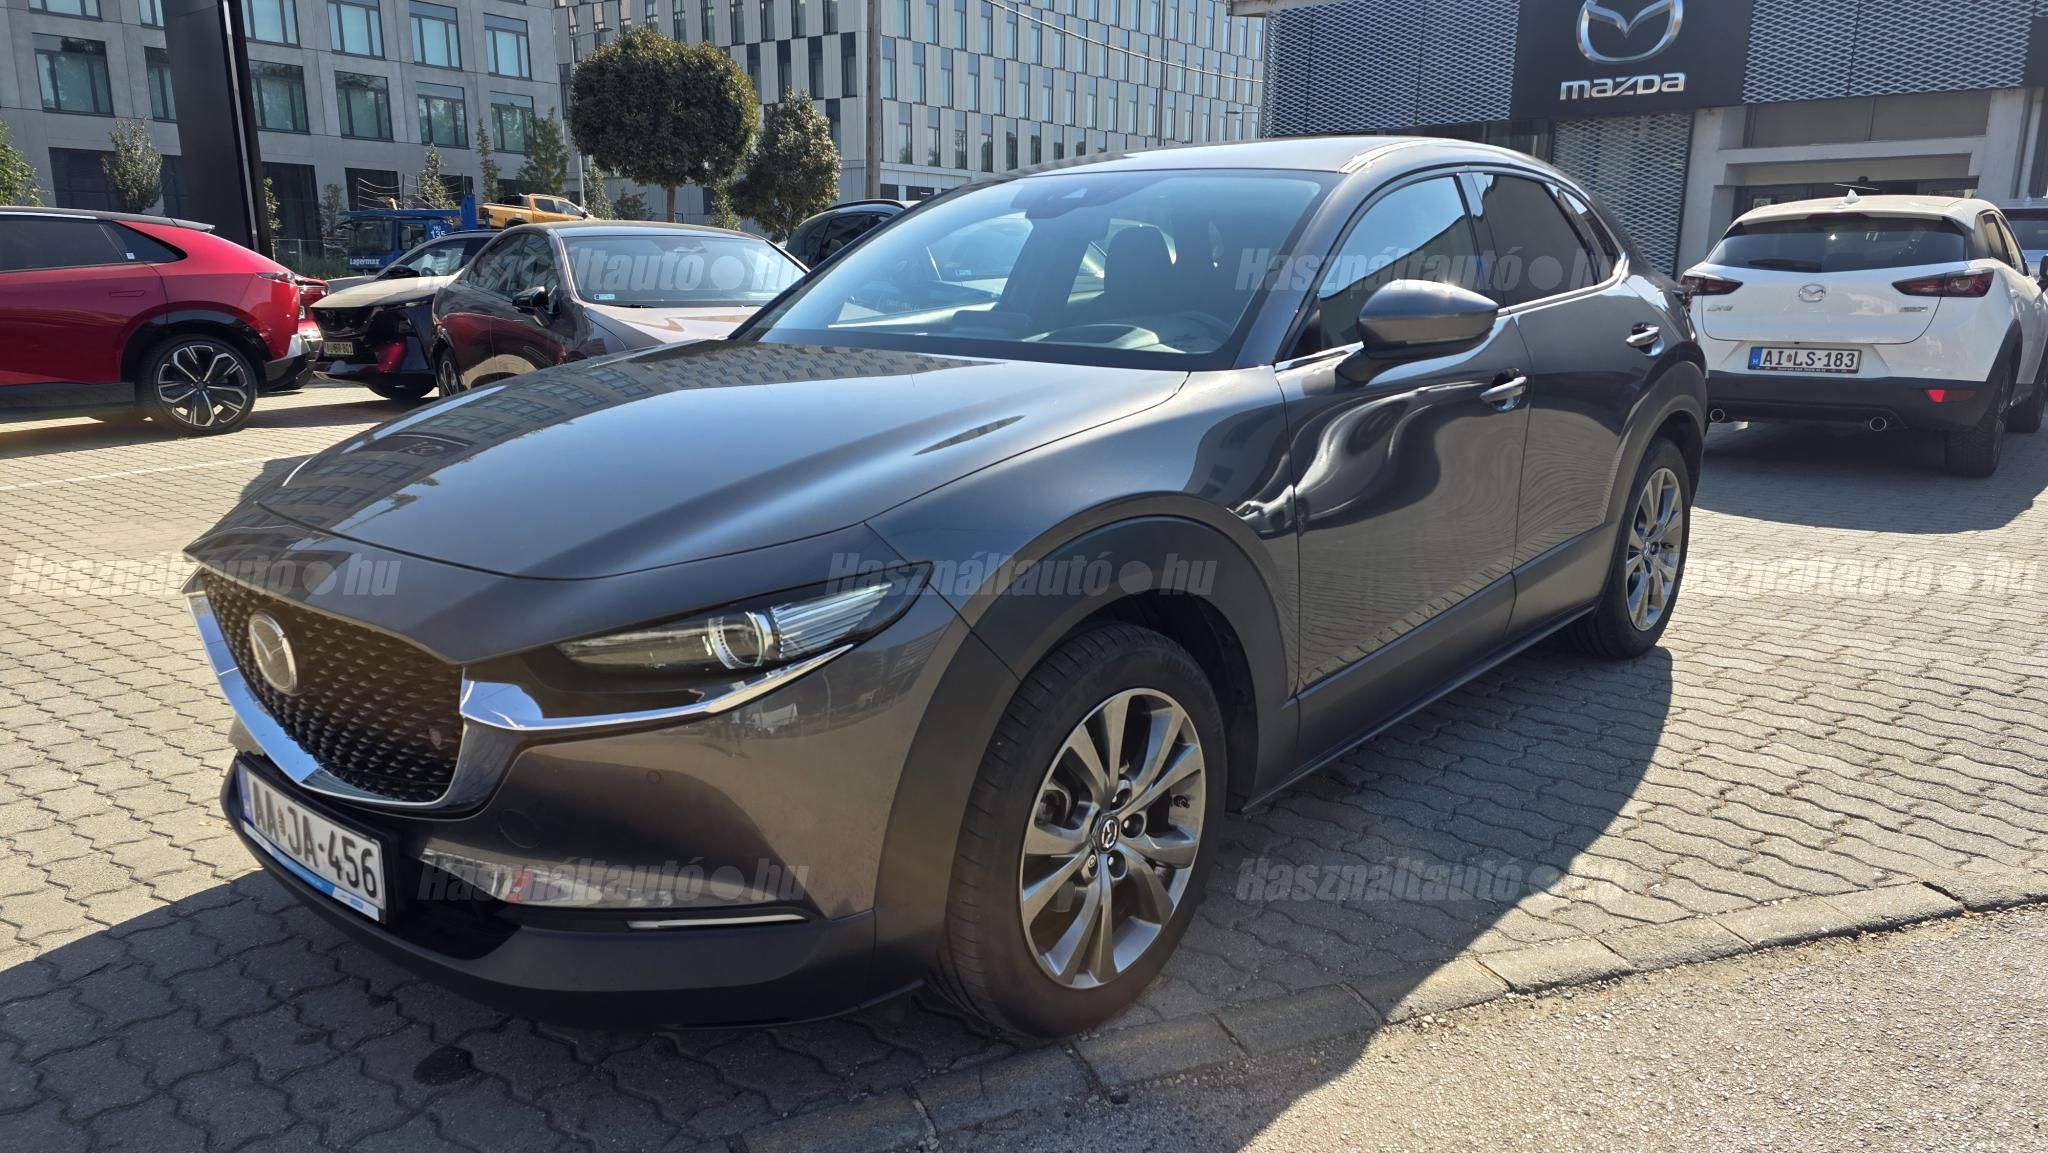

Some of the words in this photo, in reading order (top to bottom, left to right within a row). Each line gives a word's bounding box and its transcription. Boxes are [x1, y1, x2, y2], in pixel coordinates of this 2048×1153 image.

[1560, 72, 1686, 100] mazda
[349, 257, 380, 265] Lagermax
[1793, 351, 1856, 368] LS-183
[252, 781, 281, 842] AA
[287, 806, 377, 898] JA-456
